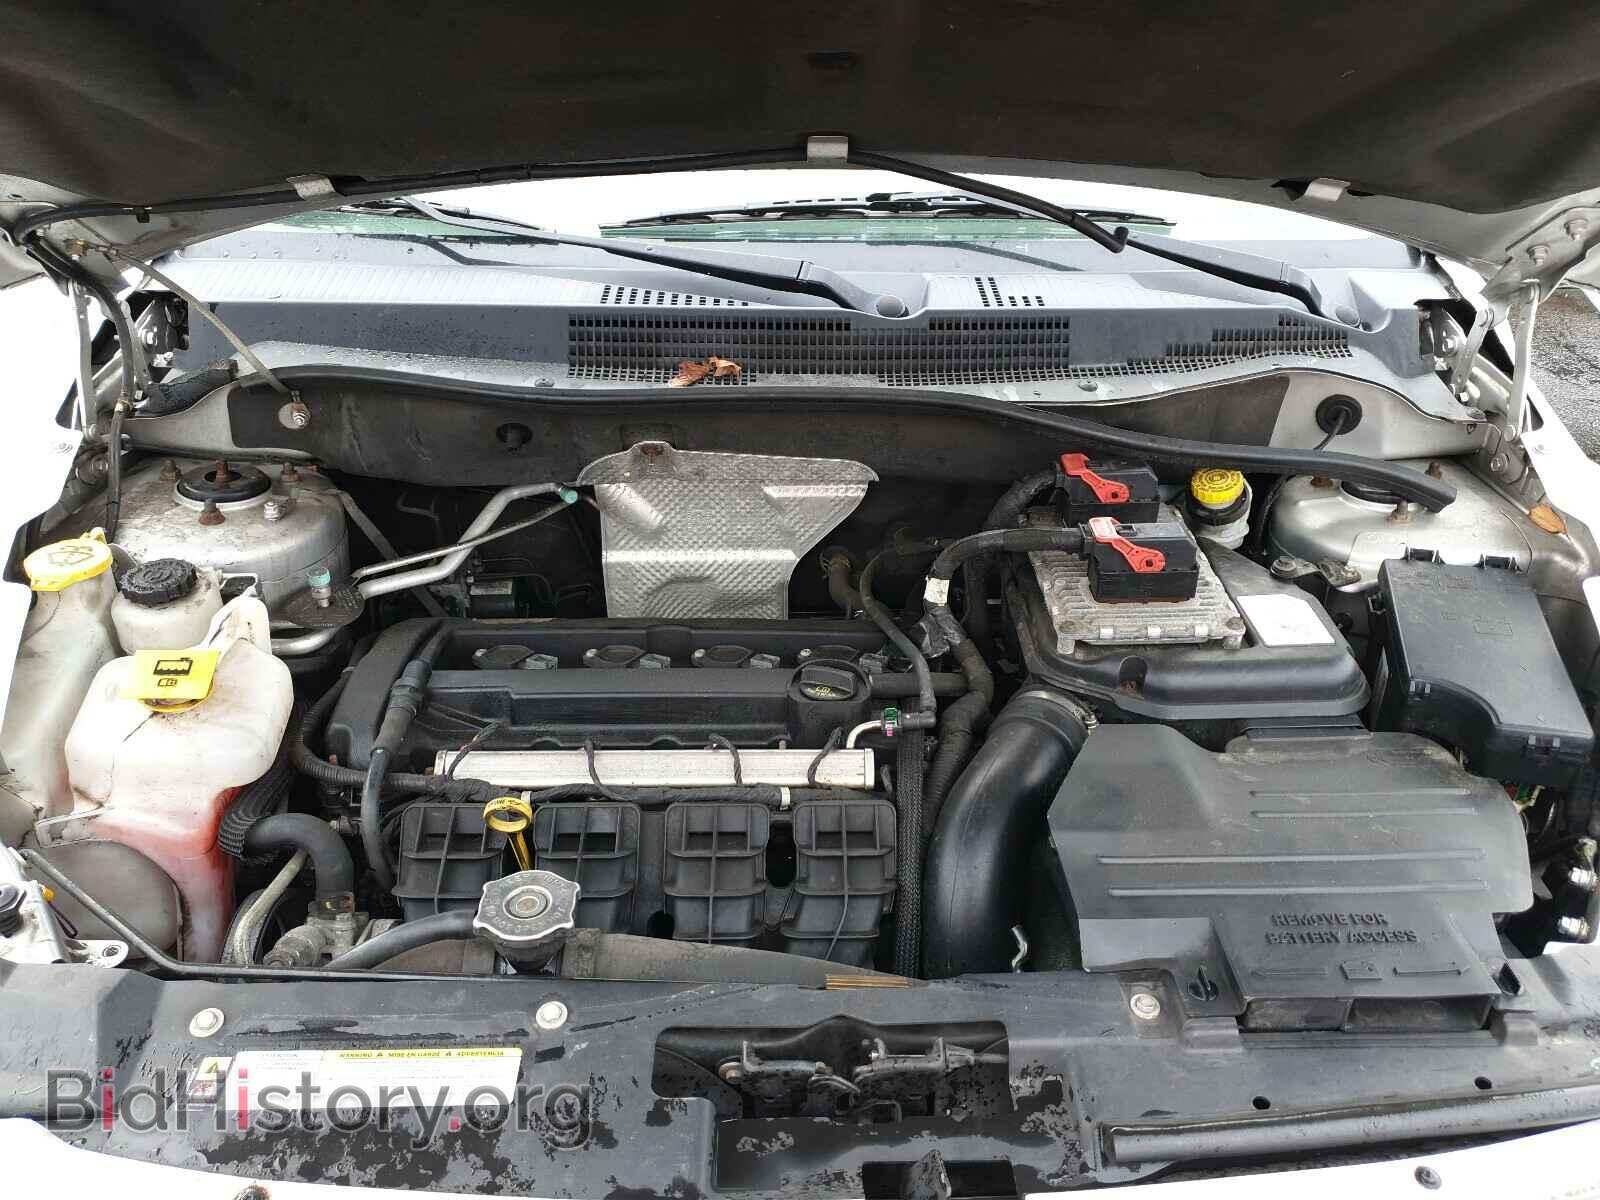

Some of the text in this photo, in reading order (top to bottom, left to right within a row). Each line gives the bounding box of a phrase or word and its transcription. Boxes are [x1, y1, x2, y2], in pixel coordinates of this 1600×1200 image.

[1271, 912, 1388, 926] REMOVE FOR
[1265, 929, 1418, 944] BATTERY ACCESS
